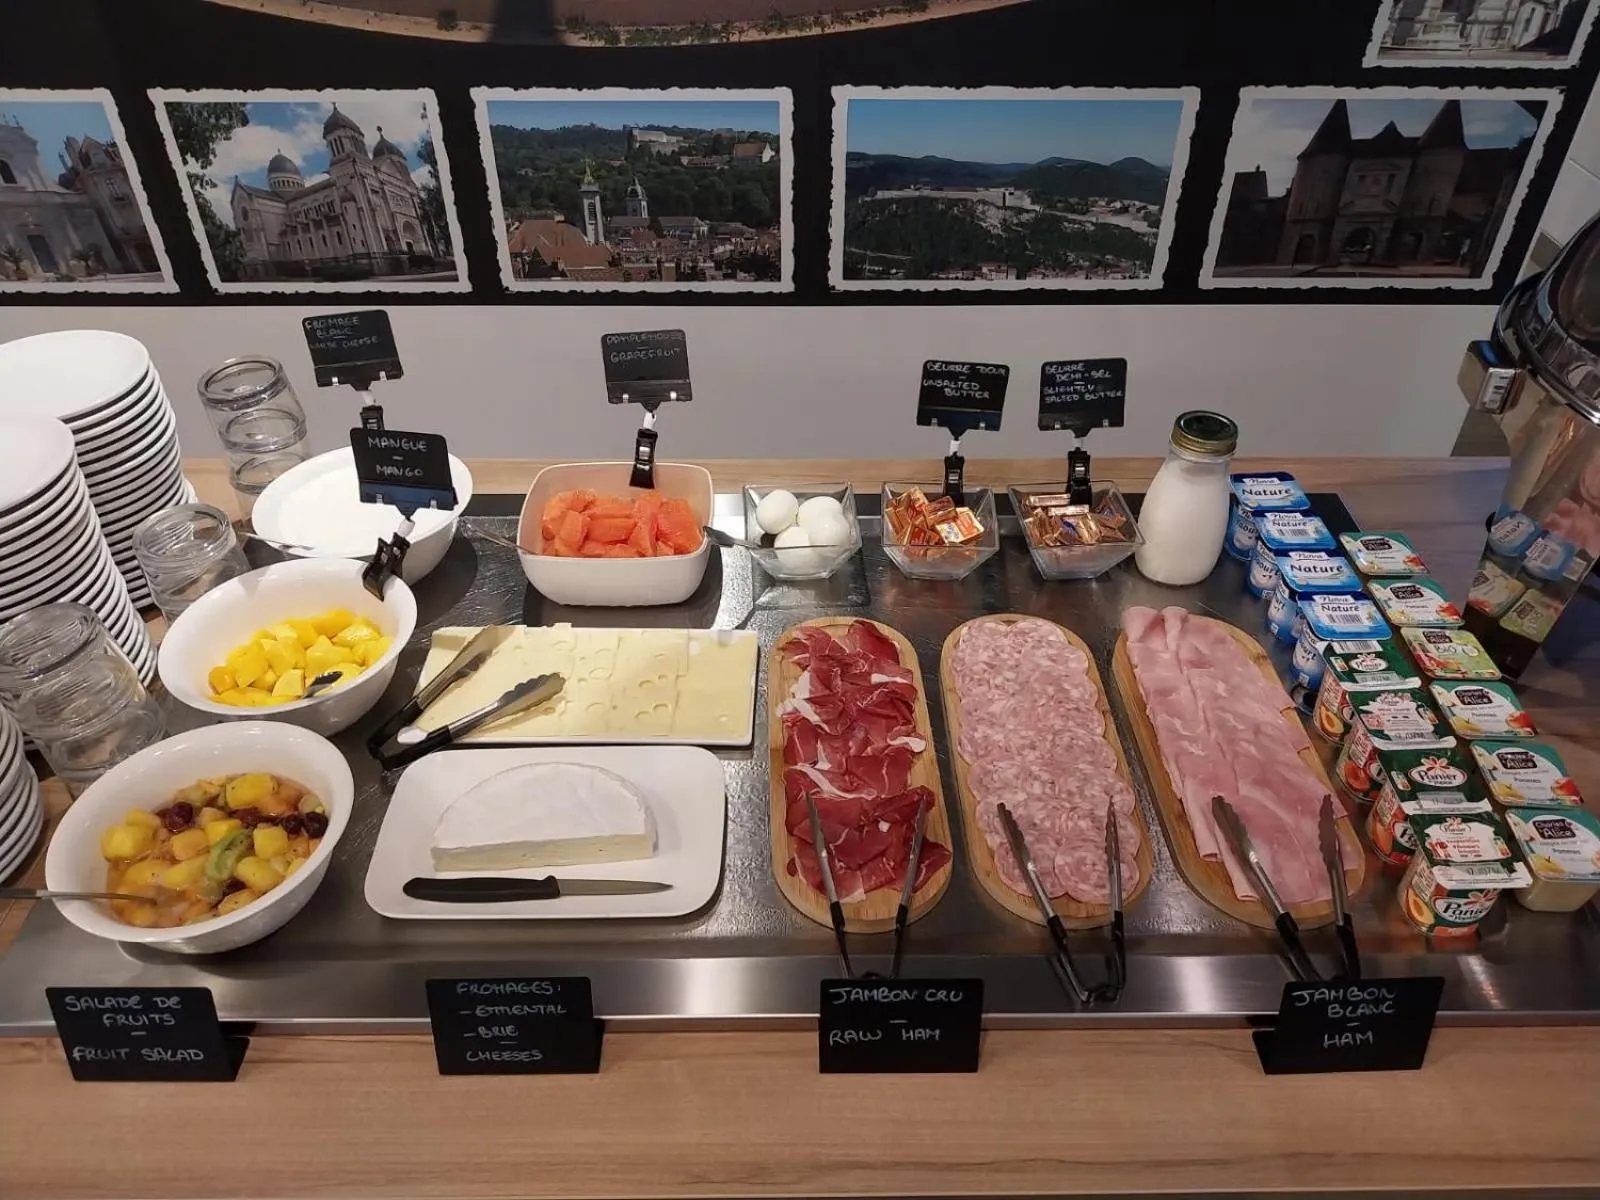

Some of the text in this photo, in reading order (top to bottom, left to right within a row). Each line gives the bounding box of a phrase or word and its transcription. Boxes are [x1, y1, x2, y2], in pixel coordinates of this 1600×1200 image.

[305, 316, 360, 330] FROMAGE
[926, 362, 972, 374] BEURRE
[1044, 363, 1085, 375] BEURRE
[923, 378, 980, 390] UNSALTED
[944, 388, 990, 400] BUTTER
[368, 436, 428, 452] MANGUE
[376, 464, 424, 477] MANGO
[1242, 488, 1291, 497] Nature
[1290, 564, 1343, 573] Nature
[1320, 604, 1361, 612] Nature
[828, 987, 963, 1005] JAMBON CRU
[1291, 986, 1395, 1006] JAMBON
[64, 995, 182, 1012] SALADE DE
[1327, 1001, 1395, 1018] BLANC
[102, 1013, 176, 1028] FRUITS
[829, 1028, 940, 1047] RAW HAM
[1323, 1031, 1374, 1048] HAM
[71, 1046, 204, 1062] FRUIT SALAD
[466, 1049, 543, 1062] CHEESES
